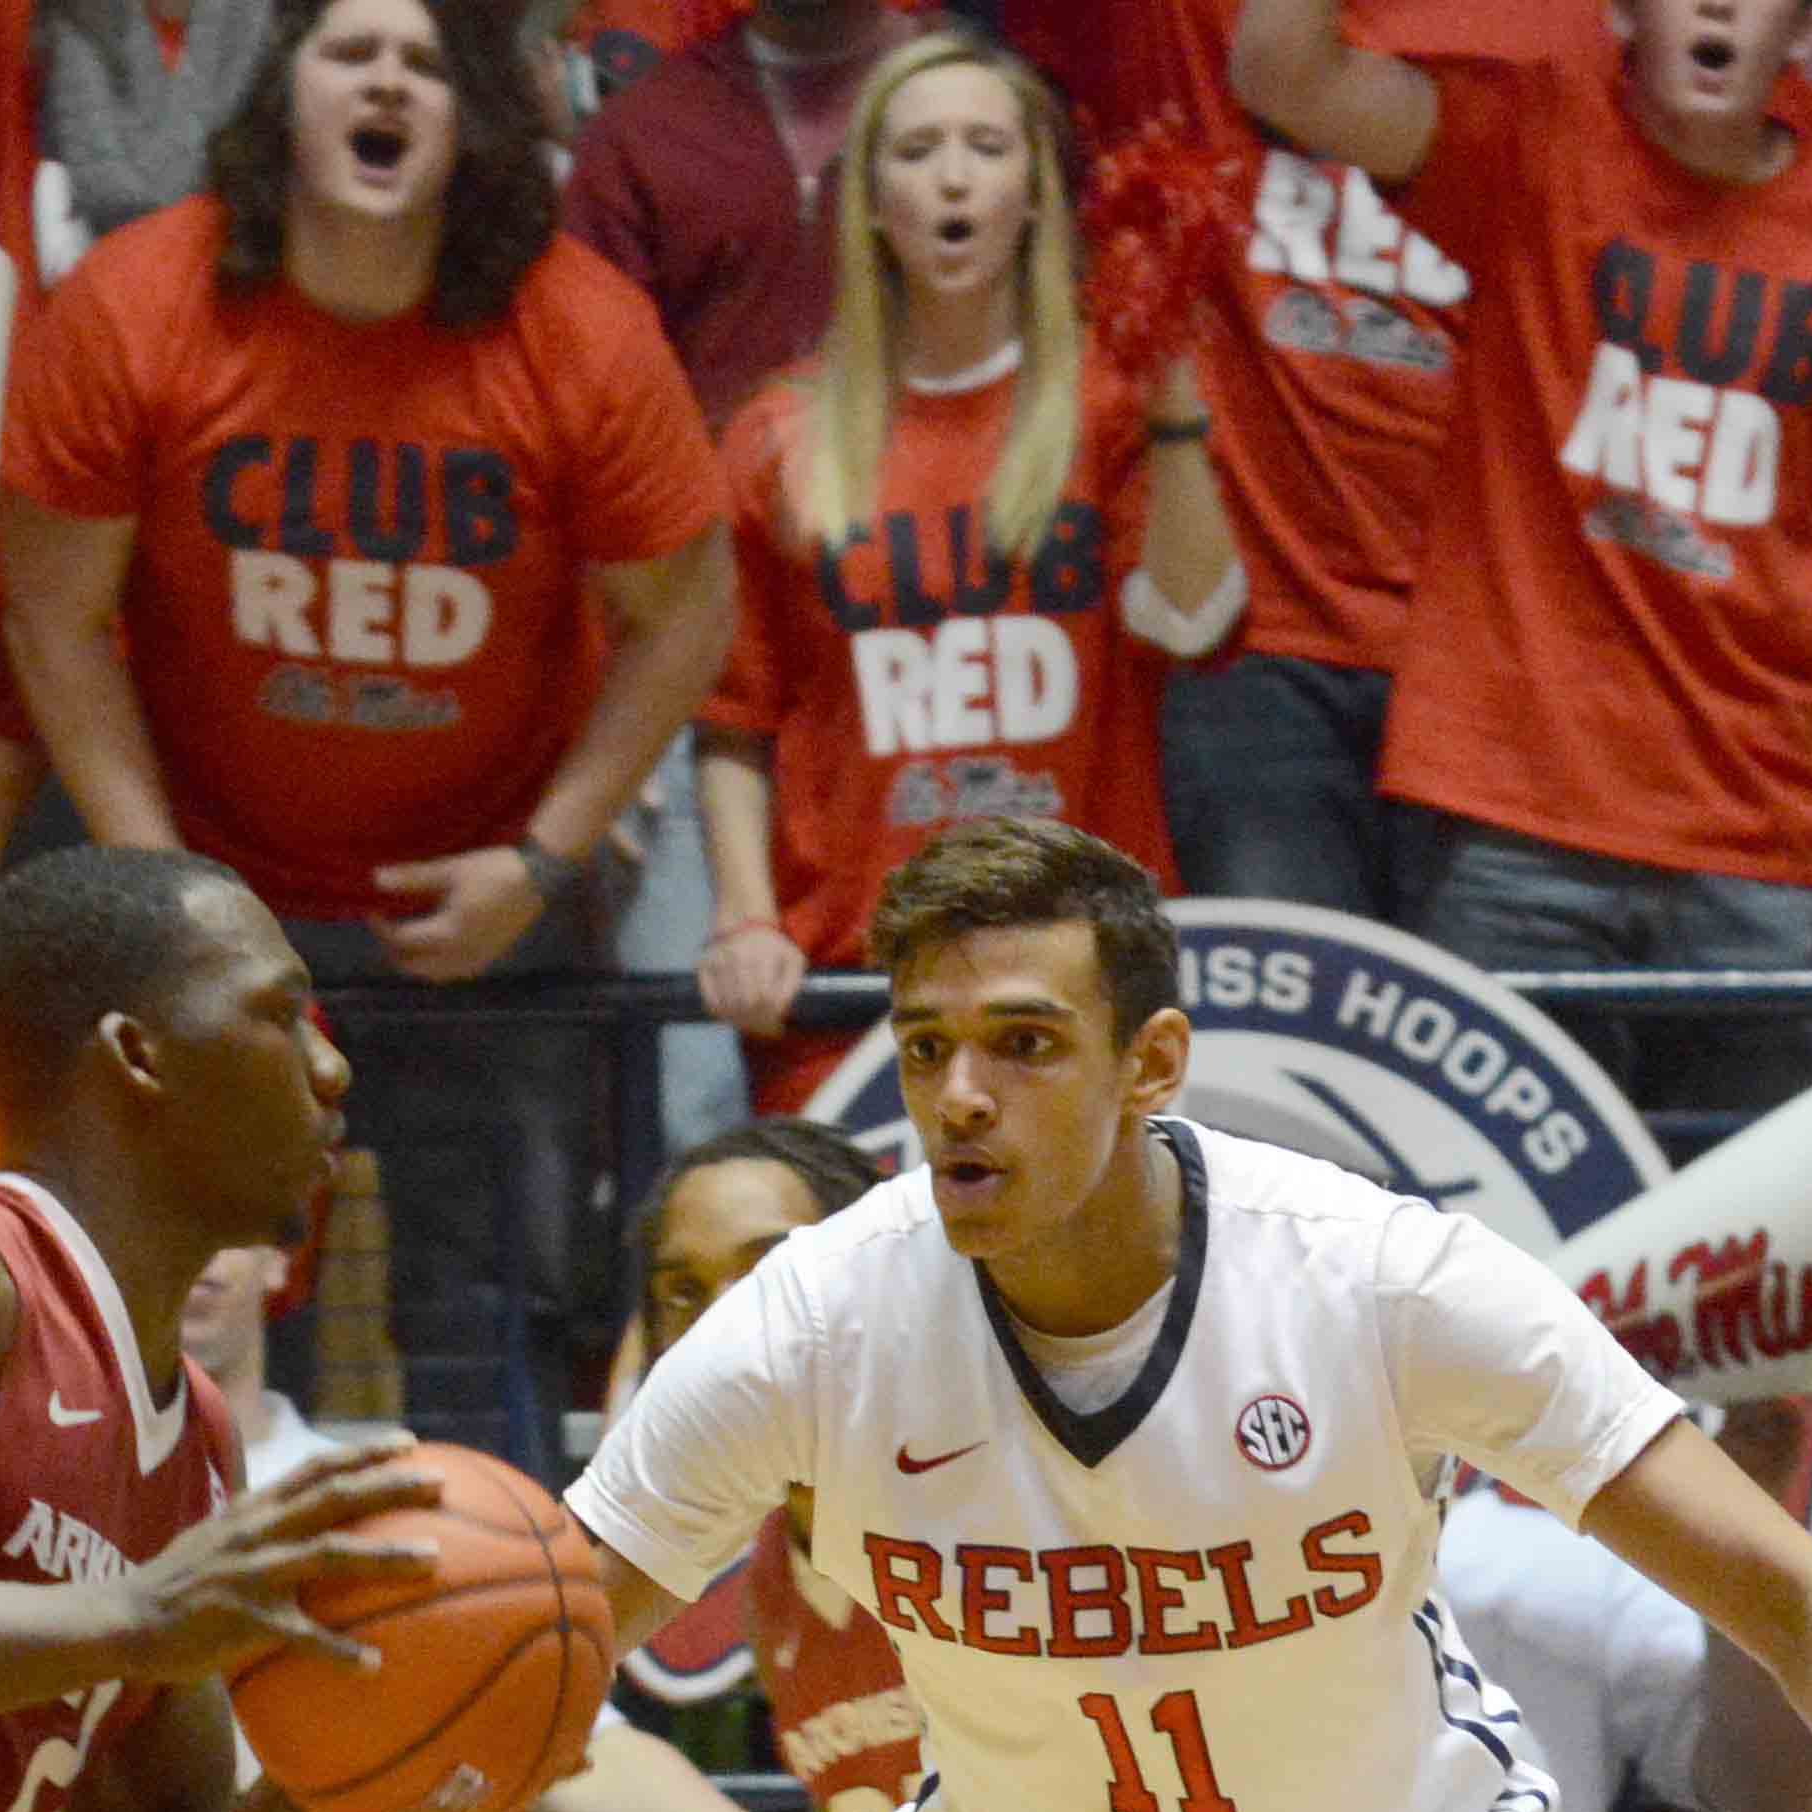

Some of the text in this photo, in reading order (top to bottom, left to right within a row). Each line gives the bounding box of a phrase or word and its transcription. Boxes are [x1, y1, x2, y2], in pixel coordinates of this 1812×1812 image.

[203, 433, 520, 567] CLUB
[1559, 341, 1781, 527] RED
[230, 548, 493, 667] RED
[819, 502, 1105, 632] CLUB
[850, 616, 1077, 757] RED
[1177, 945, 1589, 1175] ISS HOOPS
[862, 1510, 1384, 1660] REBELS
